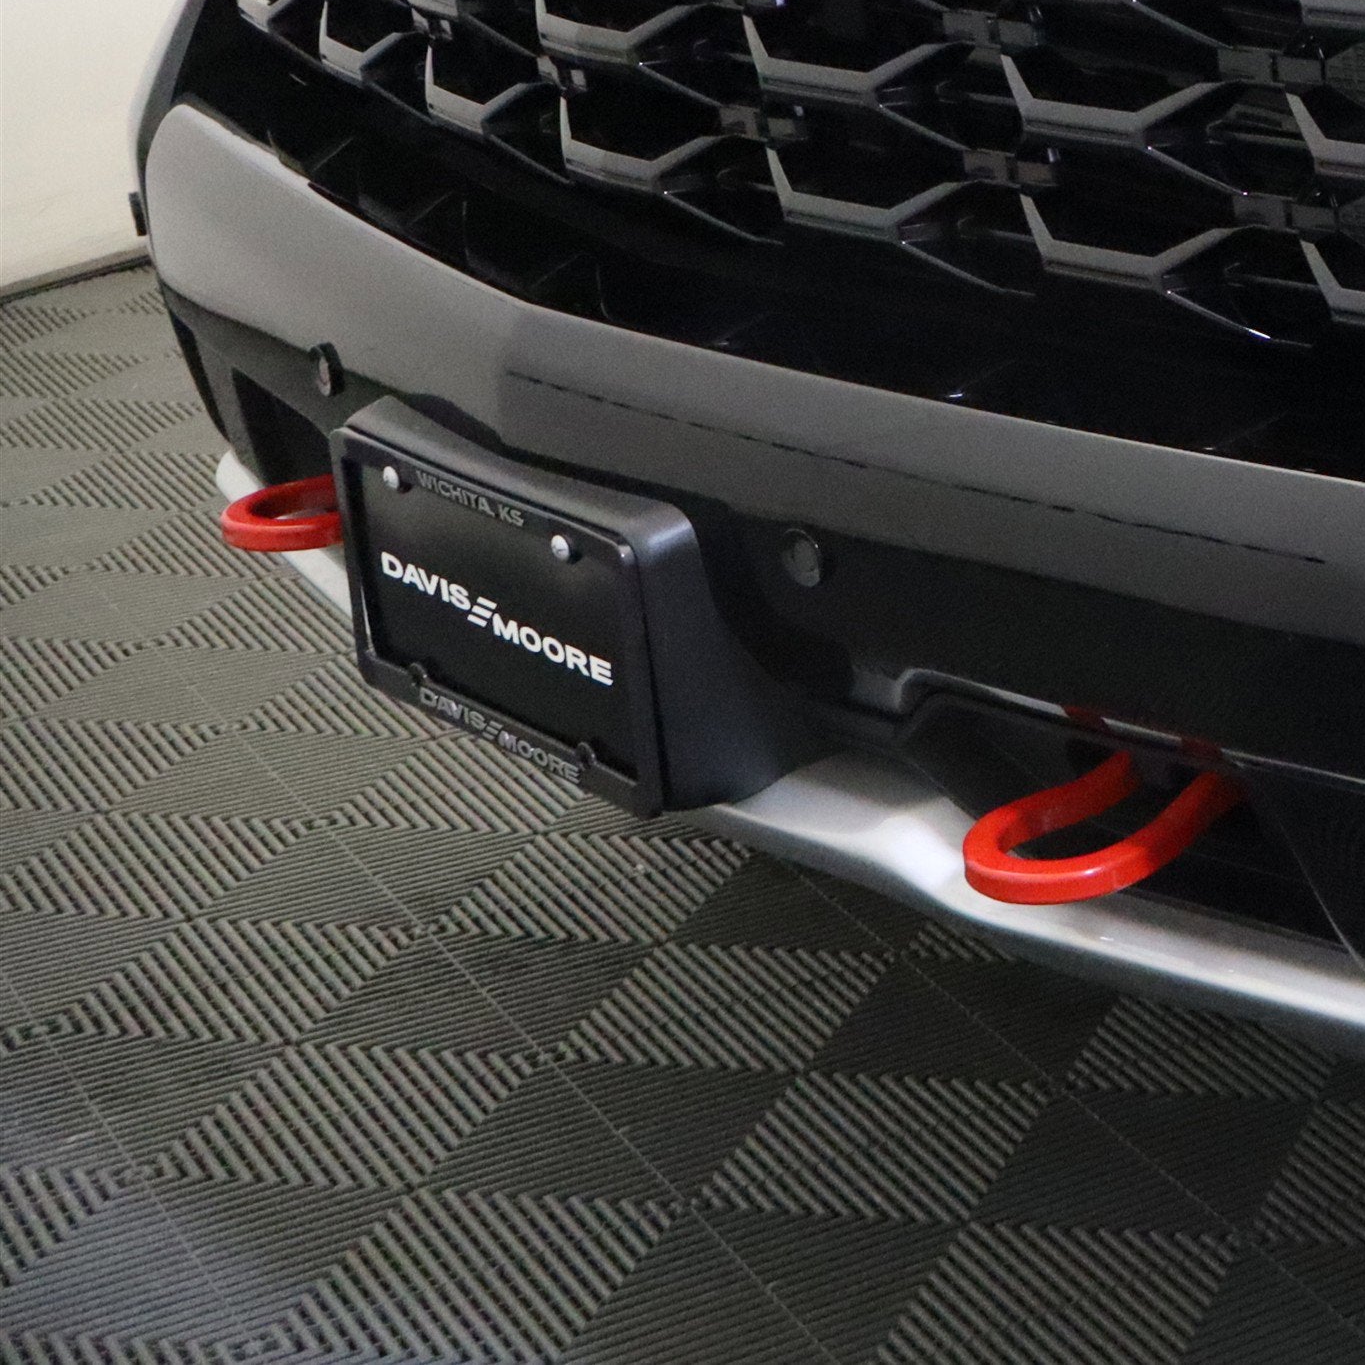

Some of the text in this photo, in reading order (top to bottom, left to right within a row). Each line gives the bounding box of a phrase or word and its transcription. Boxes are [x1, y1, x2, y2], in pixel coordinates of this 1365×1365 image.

[499, 503, 525, 527] KS
[380, 551, 614, 686] DAVIS MOORE
[419, 687, 582, 785] DAVIS MOORE
